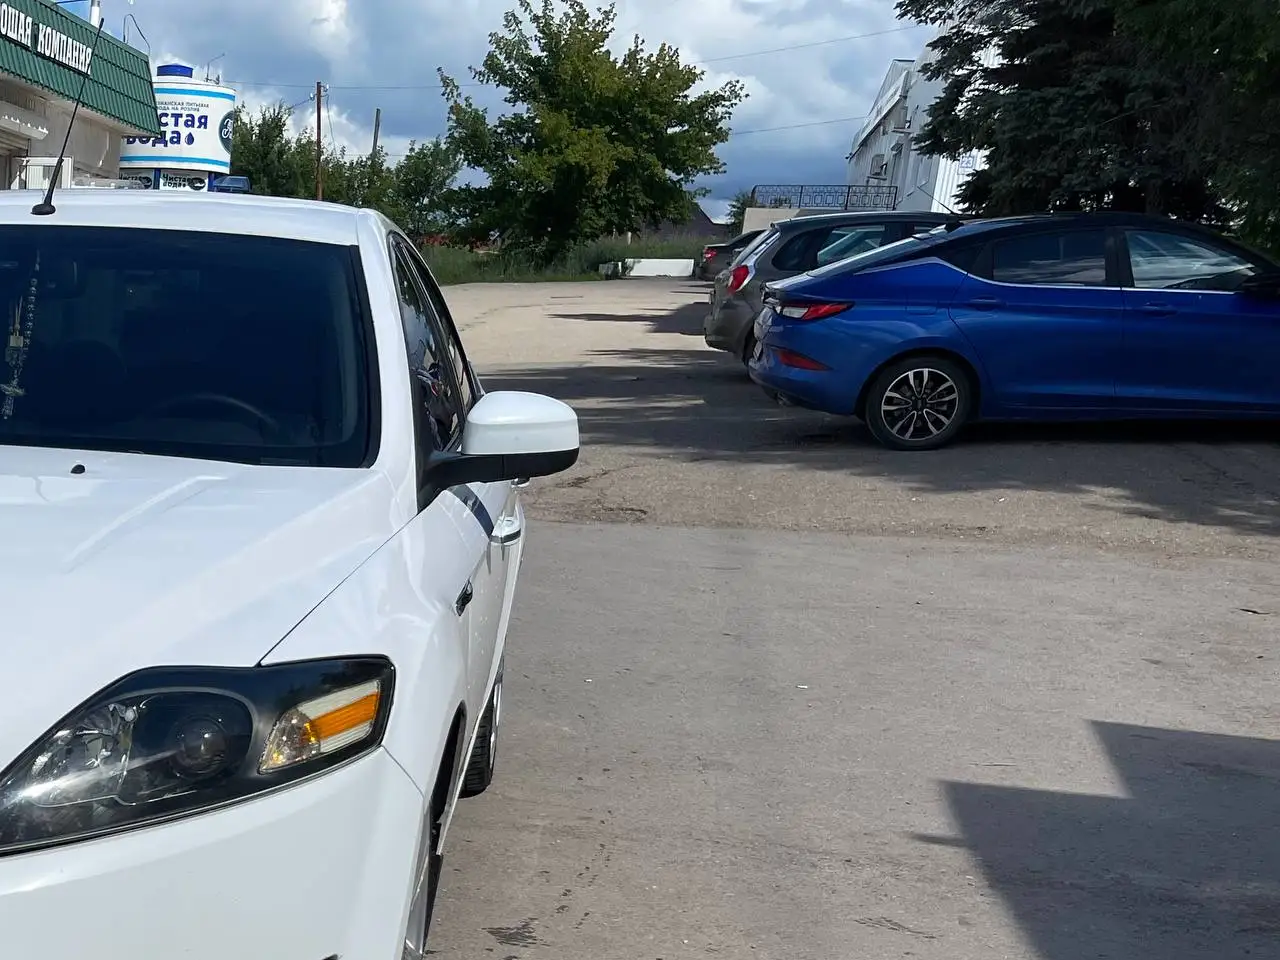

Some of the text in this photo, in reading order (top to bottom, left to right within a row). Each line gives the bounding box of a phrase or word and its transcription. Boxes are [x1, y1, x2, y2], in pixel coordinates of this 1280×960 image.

[37, 22, 93, 75] КОМПАНИЯ
[158, 112, 208, 129] стая
[961, 158, 972, 166] 23
